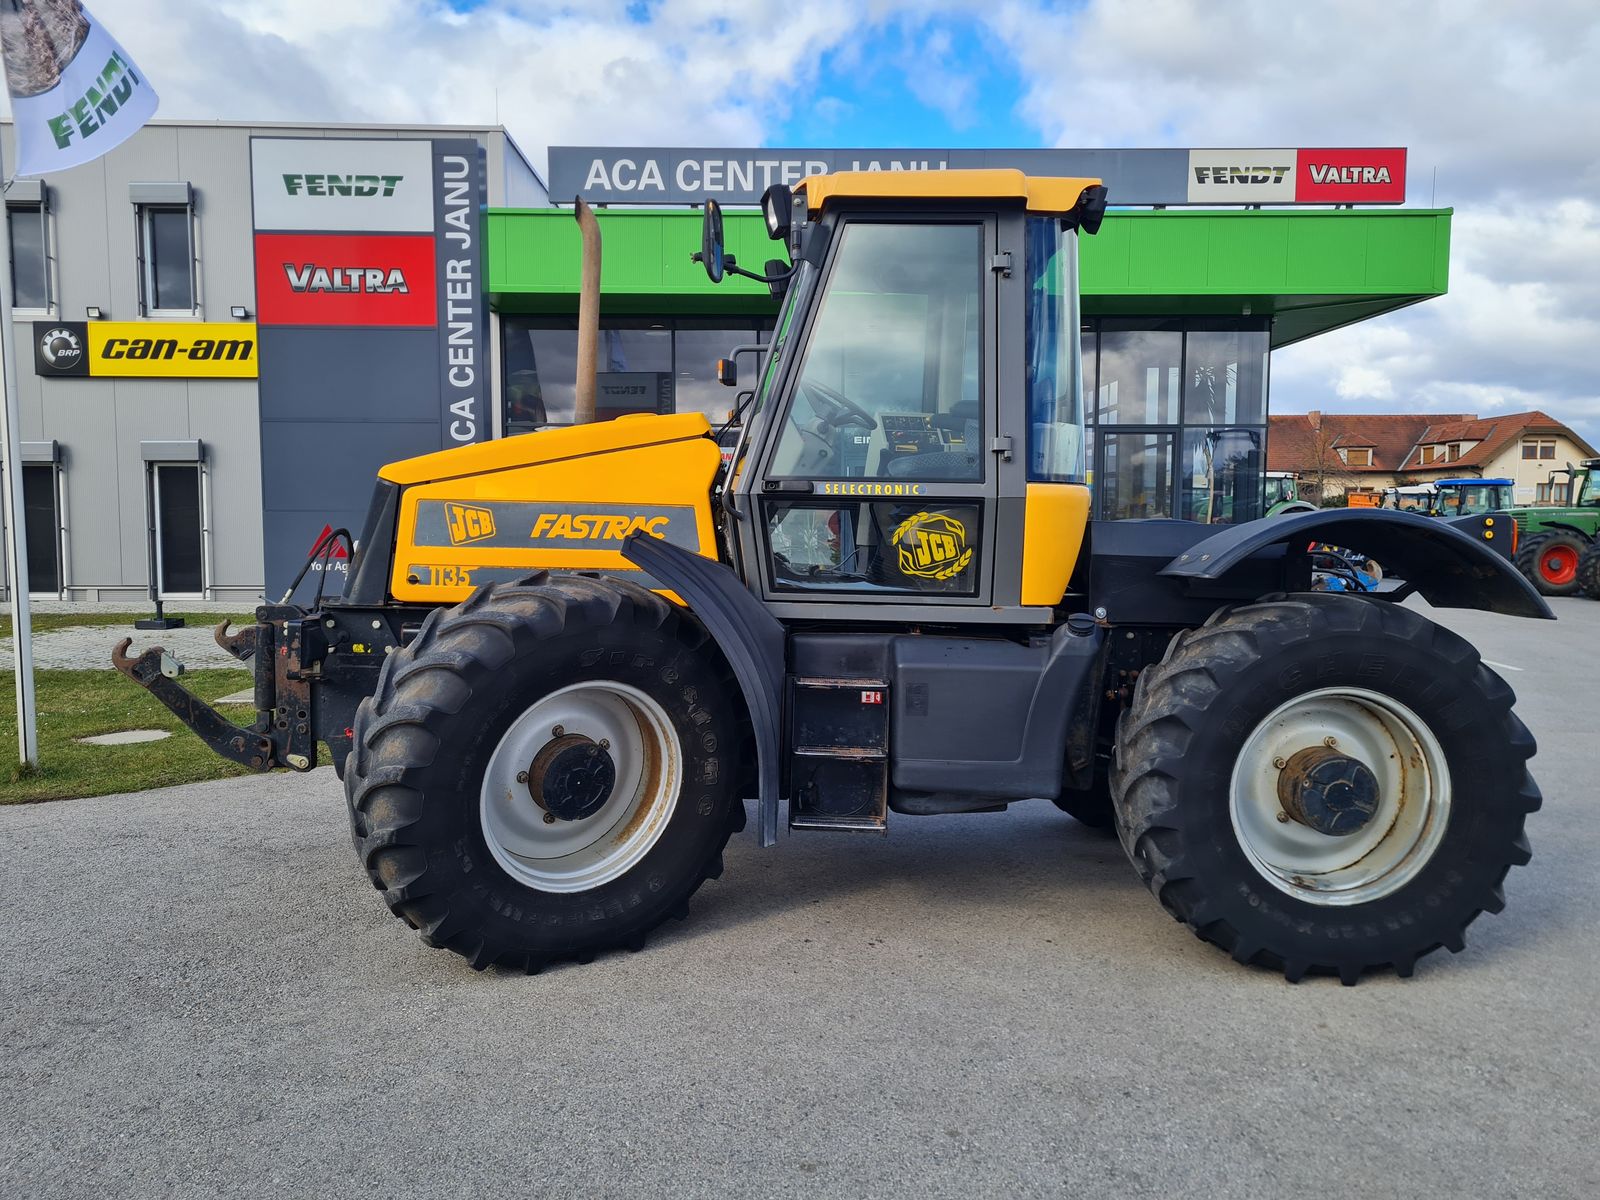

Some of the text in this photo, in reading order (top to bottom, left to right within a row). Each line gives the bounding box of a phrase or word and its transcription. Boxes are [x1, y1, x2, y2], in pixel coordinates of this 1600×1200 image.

[47, 50, 140, 150] FENDT
[282, 174, 404, 197] FENDT
[584, 159, 666, 191] ACA
[1194, 166, 1291, 185] FENDT
[1309, 164, 1392, 184] VALTRA
[283, 263, 410, 294] VALTRA
[443, 155, 476, 447] CA CENTER JANU
[57, 349, 80, 357] BRP
[101, 338, 254, 361] can-am
[825, 483, 919, 495] SELECTRONIC
[451, 506, 493, 542] JCB
[530, 513, 670, 540] FASTRAC
[916, 530, 957, 566] JCB
[429, 565, 471, 586] 1135
